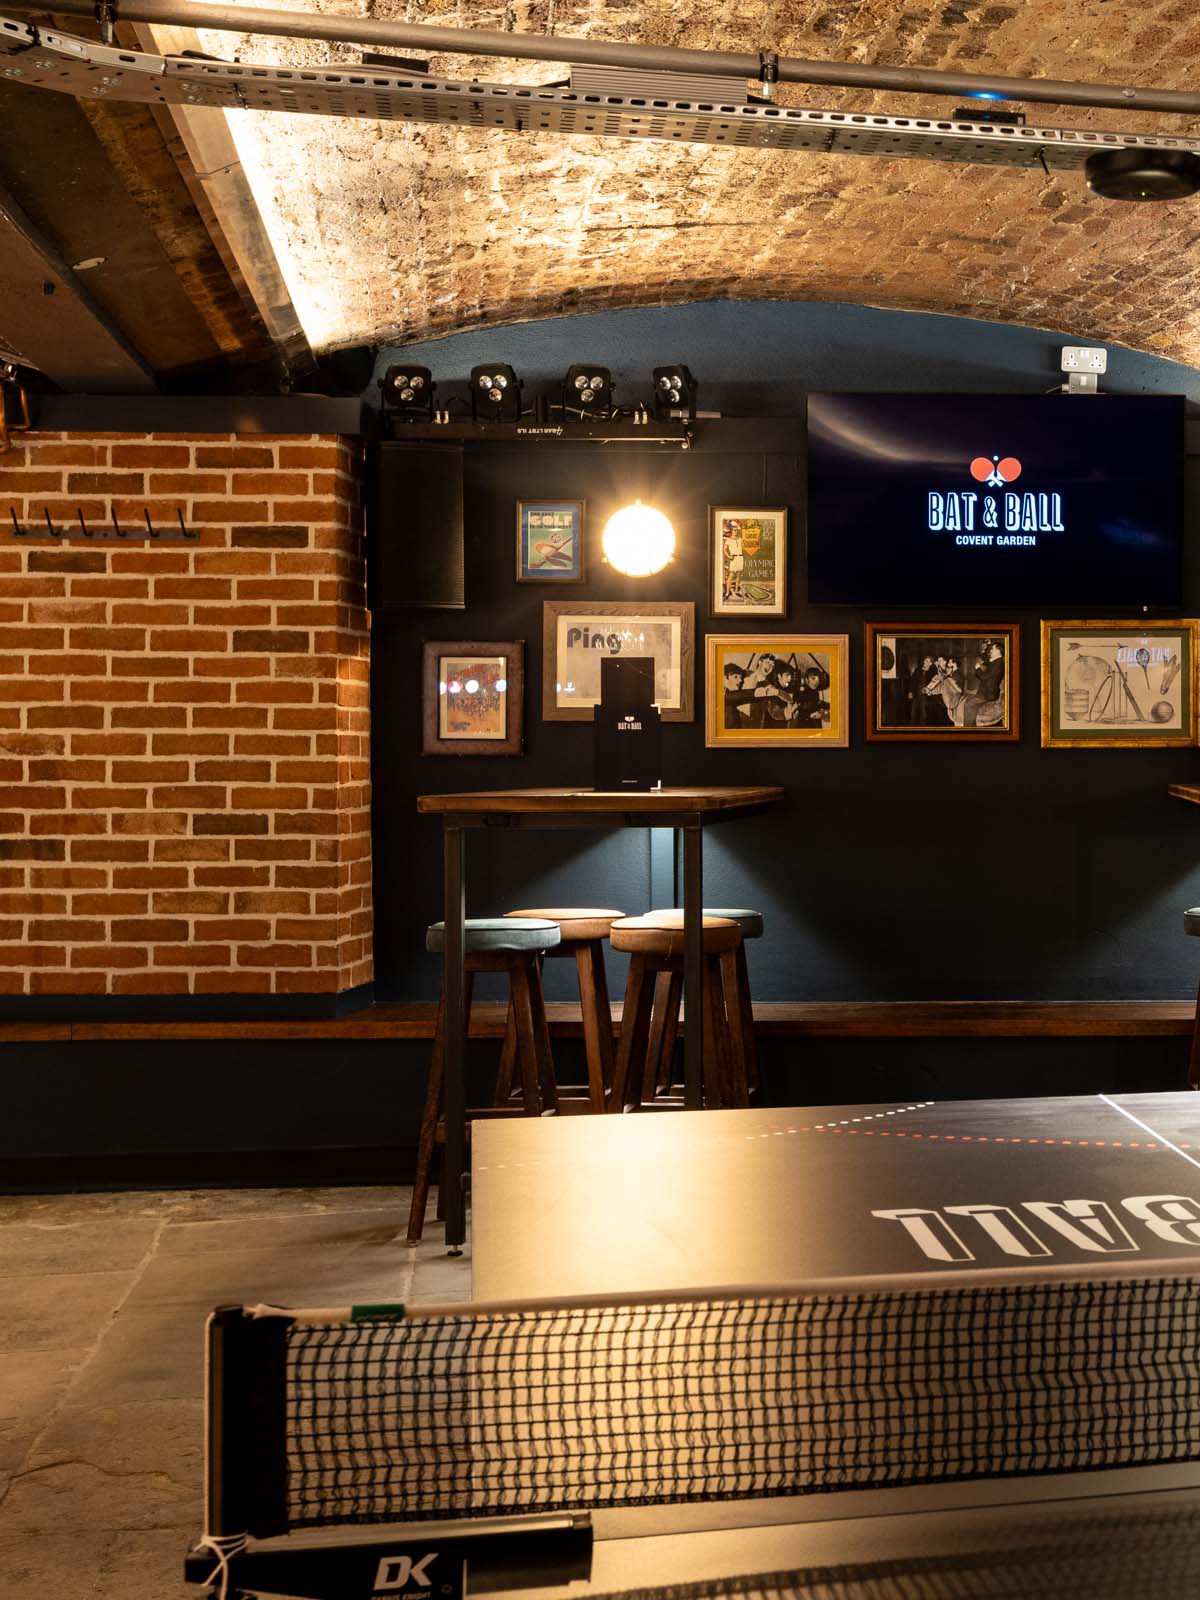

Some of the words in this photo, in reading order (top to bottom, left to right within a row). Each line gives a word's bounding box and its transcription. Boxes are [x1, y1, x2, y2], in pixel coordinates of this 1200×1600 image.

[928, 492, 978, 531] BAT
[983, 496, 998, 528] &
[1005, 492, 1065, 532] BALL
[955, 535, 994, 546] COVENT
[996, 535, 1036, 546] GARDEN
[567, 627, 622, 655] Ping
[373, 1553, 439, 1591] DK
